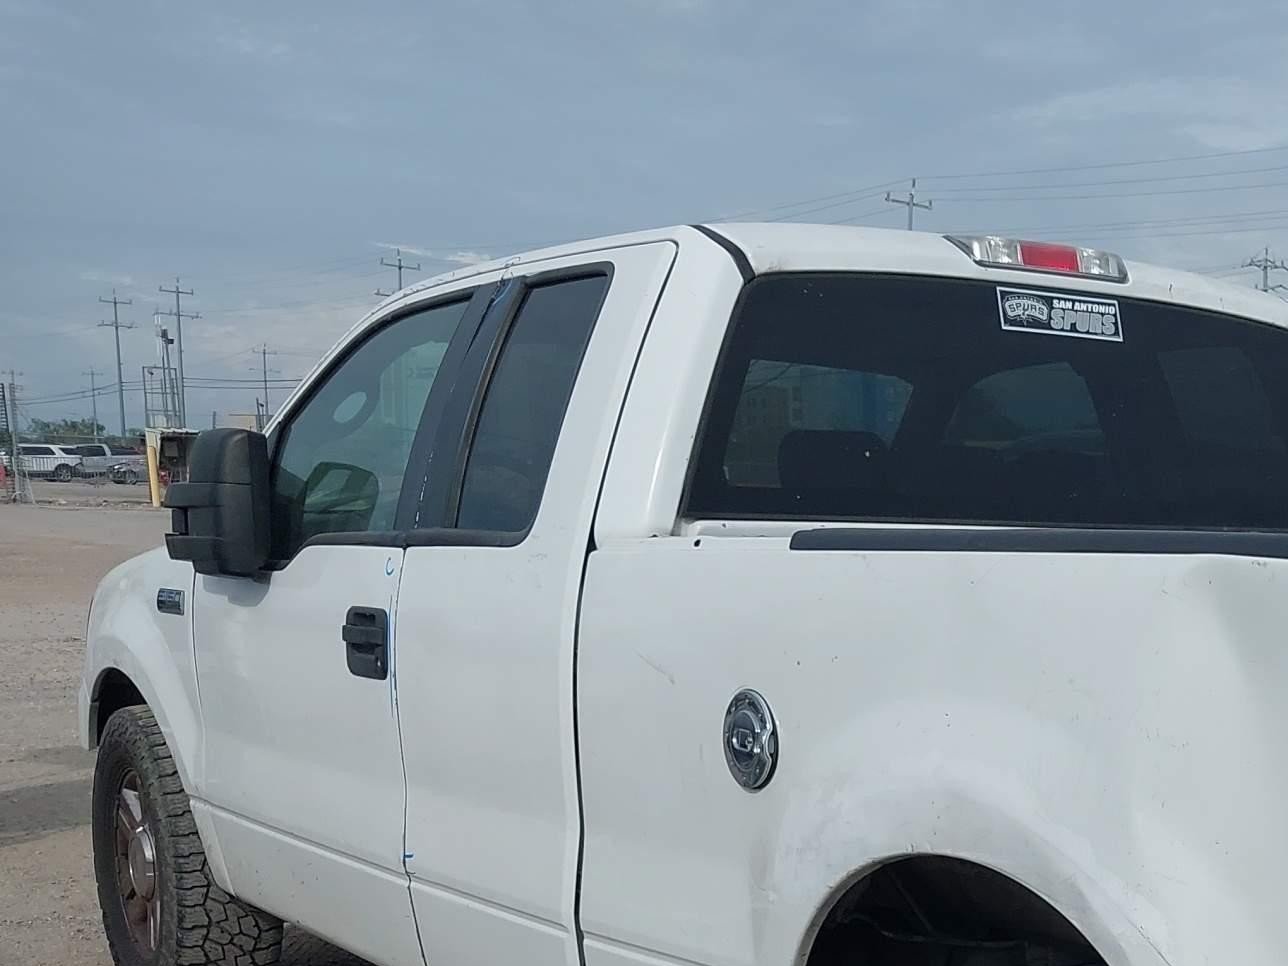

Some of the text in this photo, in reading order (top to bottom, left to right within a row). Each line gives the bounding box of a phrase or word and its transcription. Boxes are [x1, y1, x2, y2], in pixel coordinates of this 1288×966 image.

[1007, 301, 1046, 318] SPURS
[1052, 299, 1072, 310] SAN
[1073, 302, 1116, 314] ANTONIO
[1050, 308, 1116, 335] SPURS
